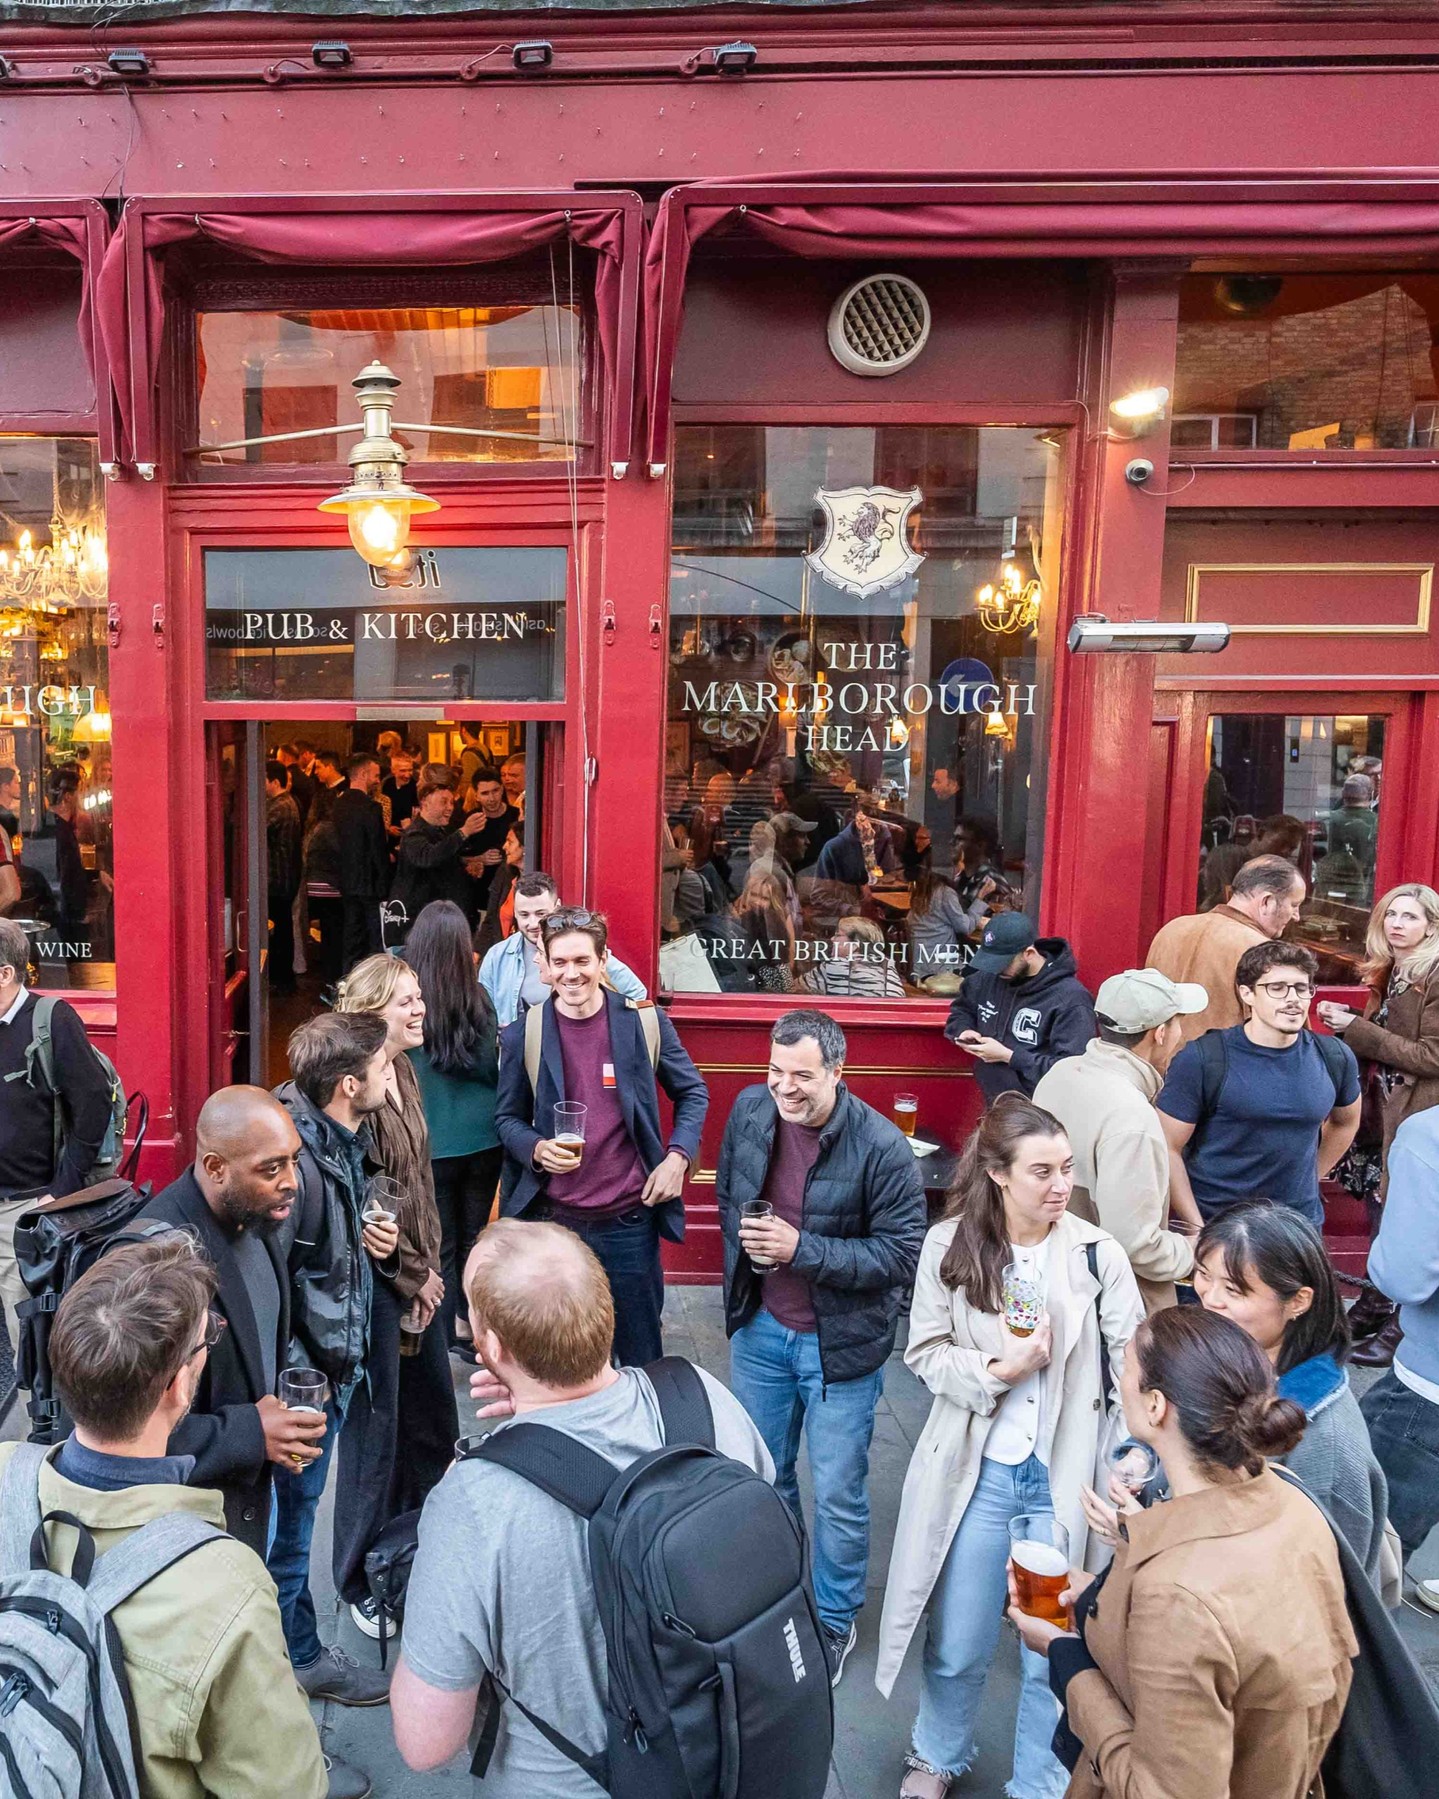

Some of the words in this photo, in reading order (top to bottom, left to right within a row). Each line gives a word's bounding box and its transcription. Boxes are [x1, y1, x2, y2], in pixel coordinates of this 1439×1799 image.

[244, 613, 314, 640] PUB
[329, 619, 349, 640] &
[363, 612, 527, 640] KITCHEN
[823, 642, 897, 670] THE
[681, 680, 1038, 716] MARLBOROUGH
[804, 724, 909, 752] HEAD
[35, 942, 92, 958] WINE
[690, 938, 786, 960] GREAT
[794, 940, 909, 963] BRITISH
[782, 1617, 807, 1683] THULE
